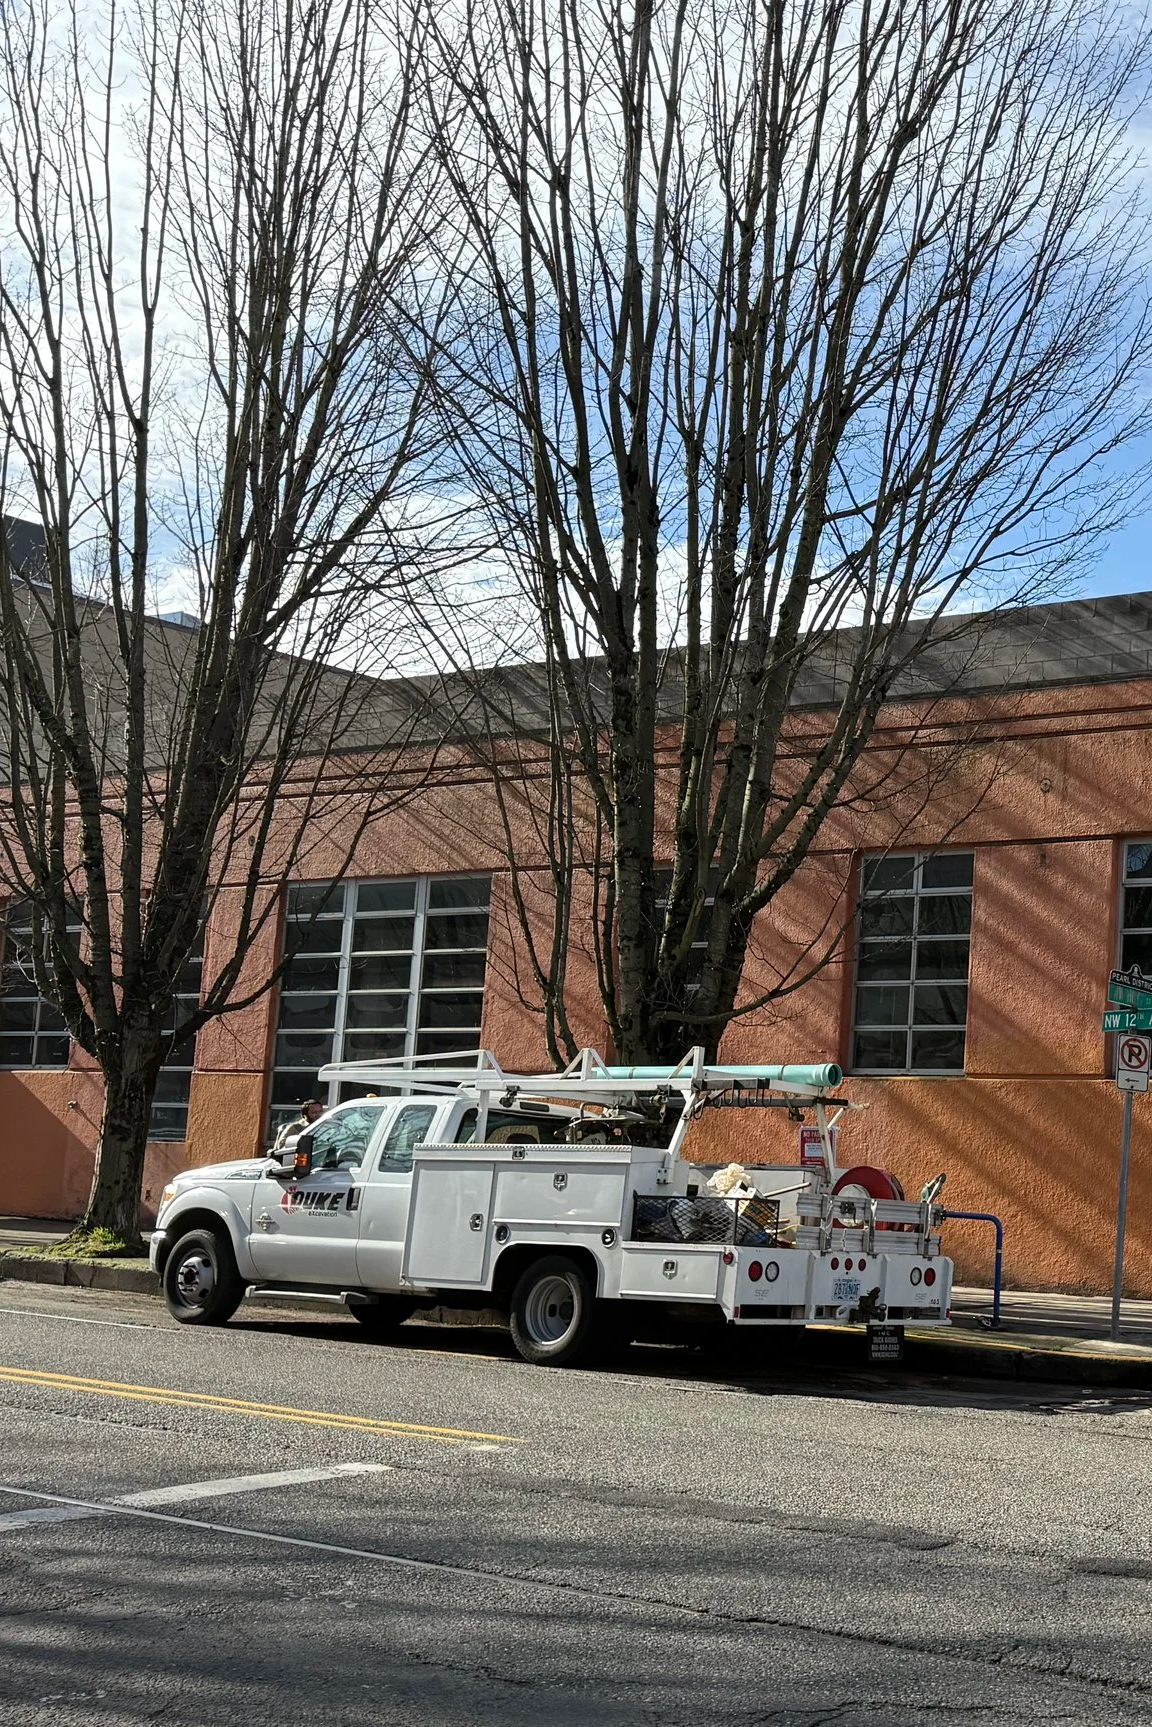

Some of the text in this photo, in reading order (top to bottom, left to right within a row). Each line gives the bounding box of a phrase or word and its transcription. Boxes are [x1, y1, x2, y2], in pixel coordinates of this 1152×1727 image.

[1112, 972, 1130, 985] PEARL
[1104, 1014, 1121, 1029] NW
[290, 1190, 346, 1211] DUKE
